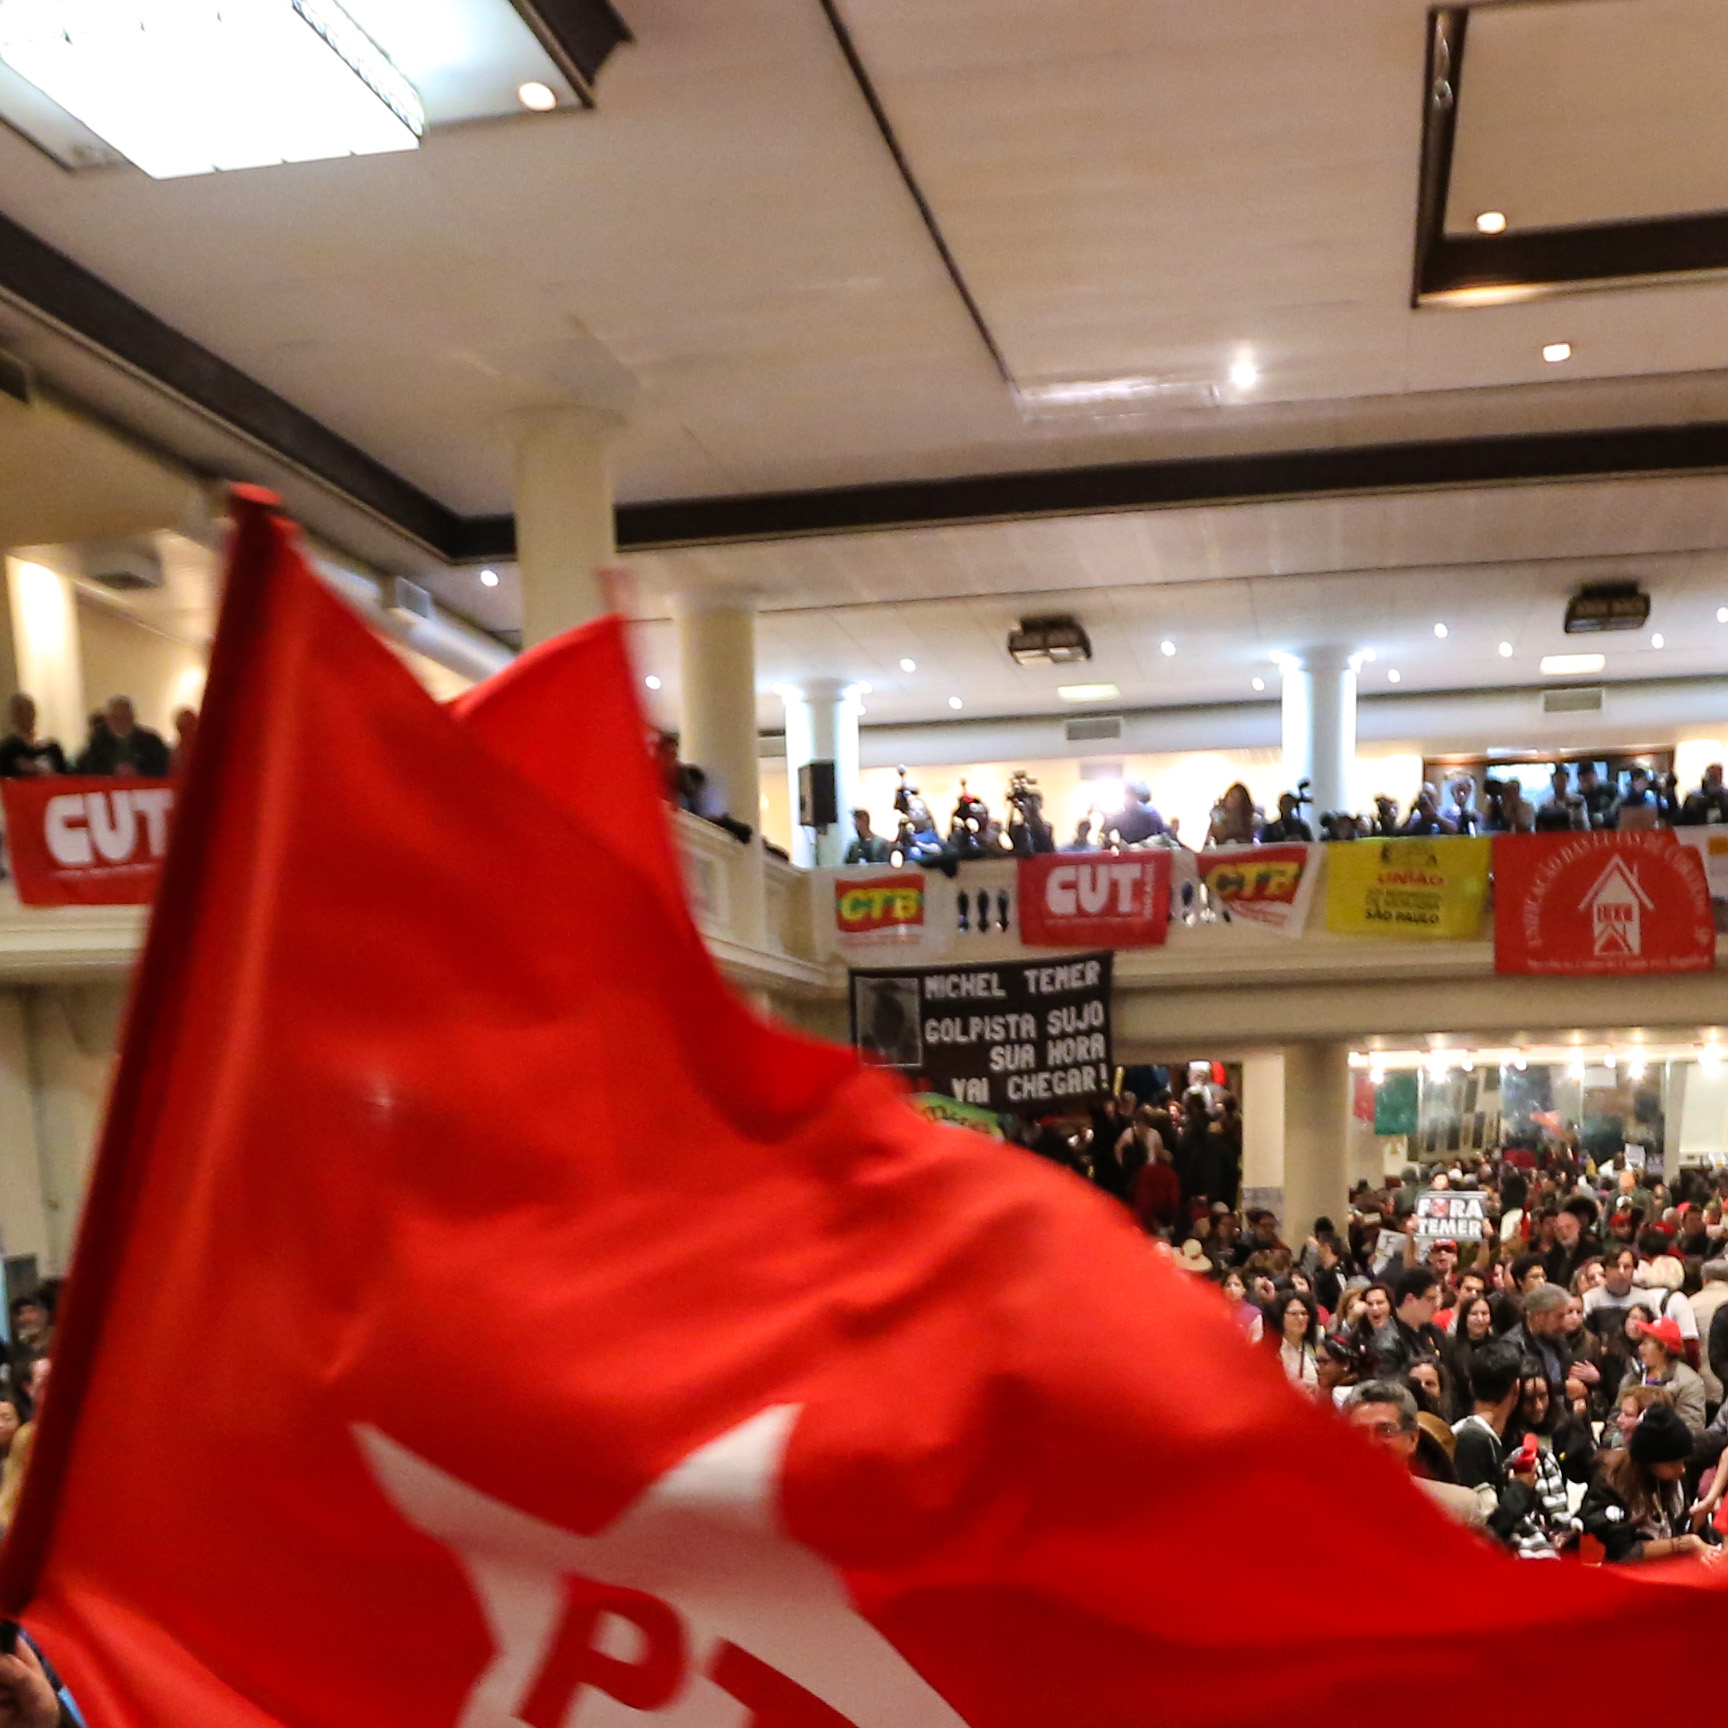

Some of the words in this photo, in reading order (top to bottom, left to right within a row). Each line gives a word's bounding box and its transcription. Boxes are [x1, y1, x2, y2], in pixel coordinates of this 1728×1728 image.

[44, 788, 173, 868] CUT
[1046, 863, 1142, 915] CUT
[1205, 860, 1303, 899] CTB
[840, 887, 920, 921] CTB
[924, 971, 1007, 1000] MICHEL
[1024, 960, 1101, 995] TEMER
[924, 1012, 1037, 1044] GOLPISTA
[1046, 1000, 1105, 1035] SUJO
[989, 1043, 1036, 1073] SUA
[1046, 1032, 1106, 1067] HORA
[951, 1077, 991, 1104] VAI
[1006, 1065, 1110, 1102] CHEGAR!
[1417, 1218, 1483, 1236] TEMER
